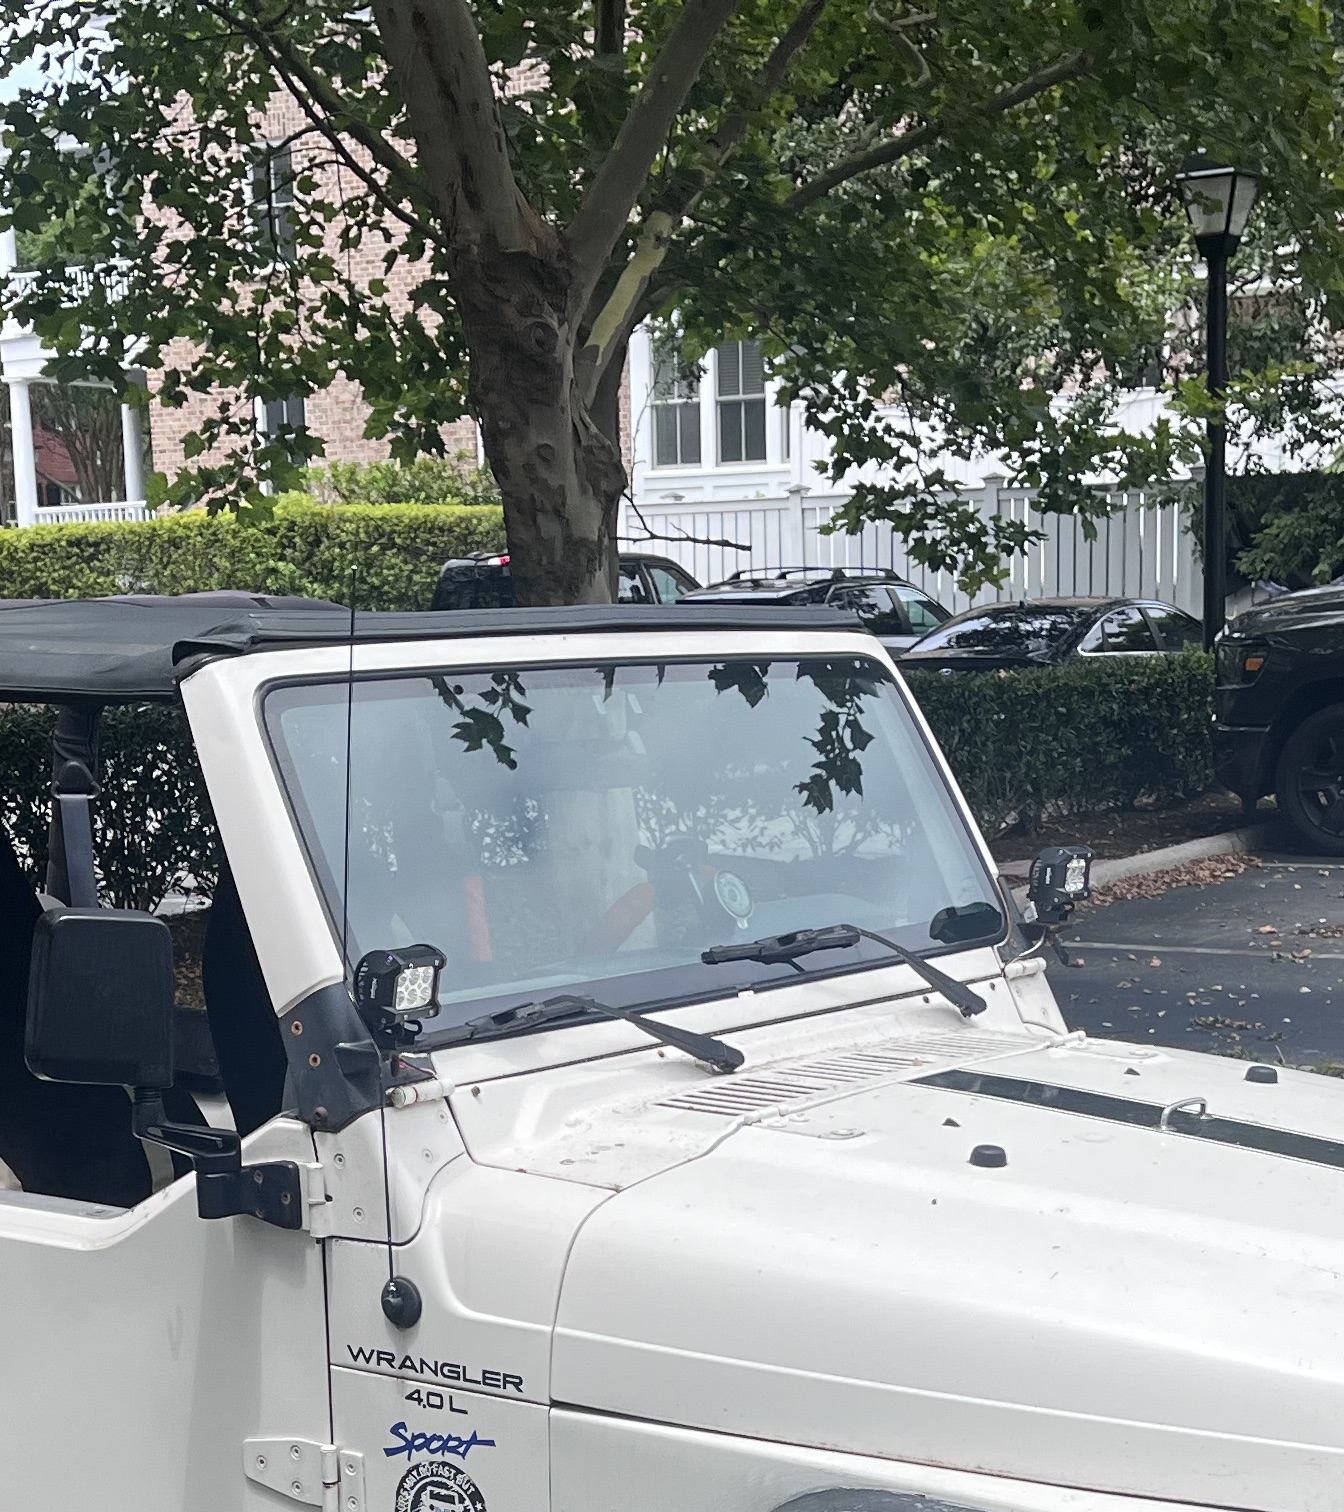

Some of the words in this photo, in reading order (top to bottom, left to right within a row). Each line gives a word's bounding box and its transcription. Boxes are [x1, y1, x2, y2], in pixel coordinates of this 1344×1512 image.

[347, 1344, 524, 1393] WRANGLER
[449, 1395, 468, 1415] L
[383, 1421, 496, 1462] Sport
